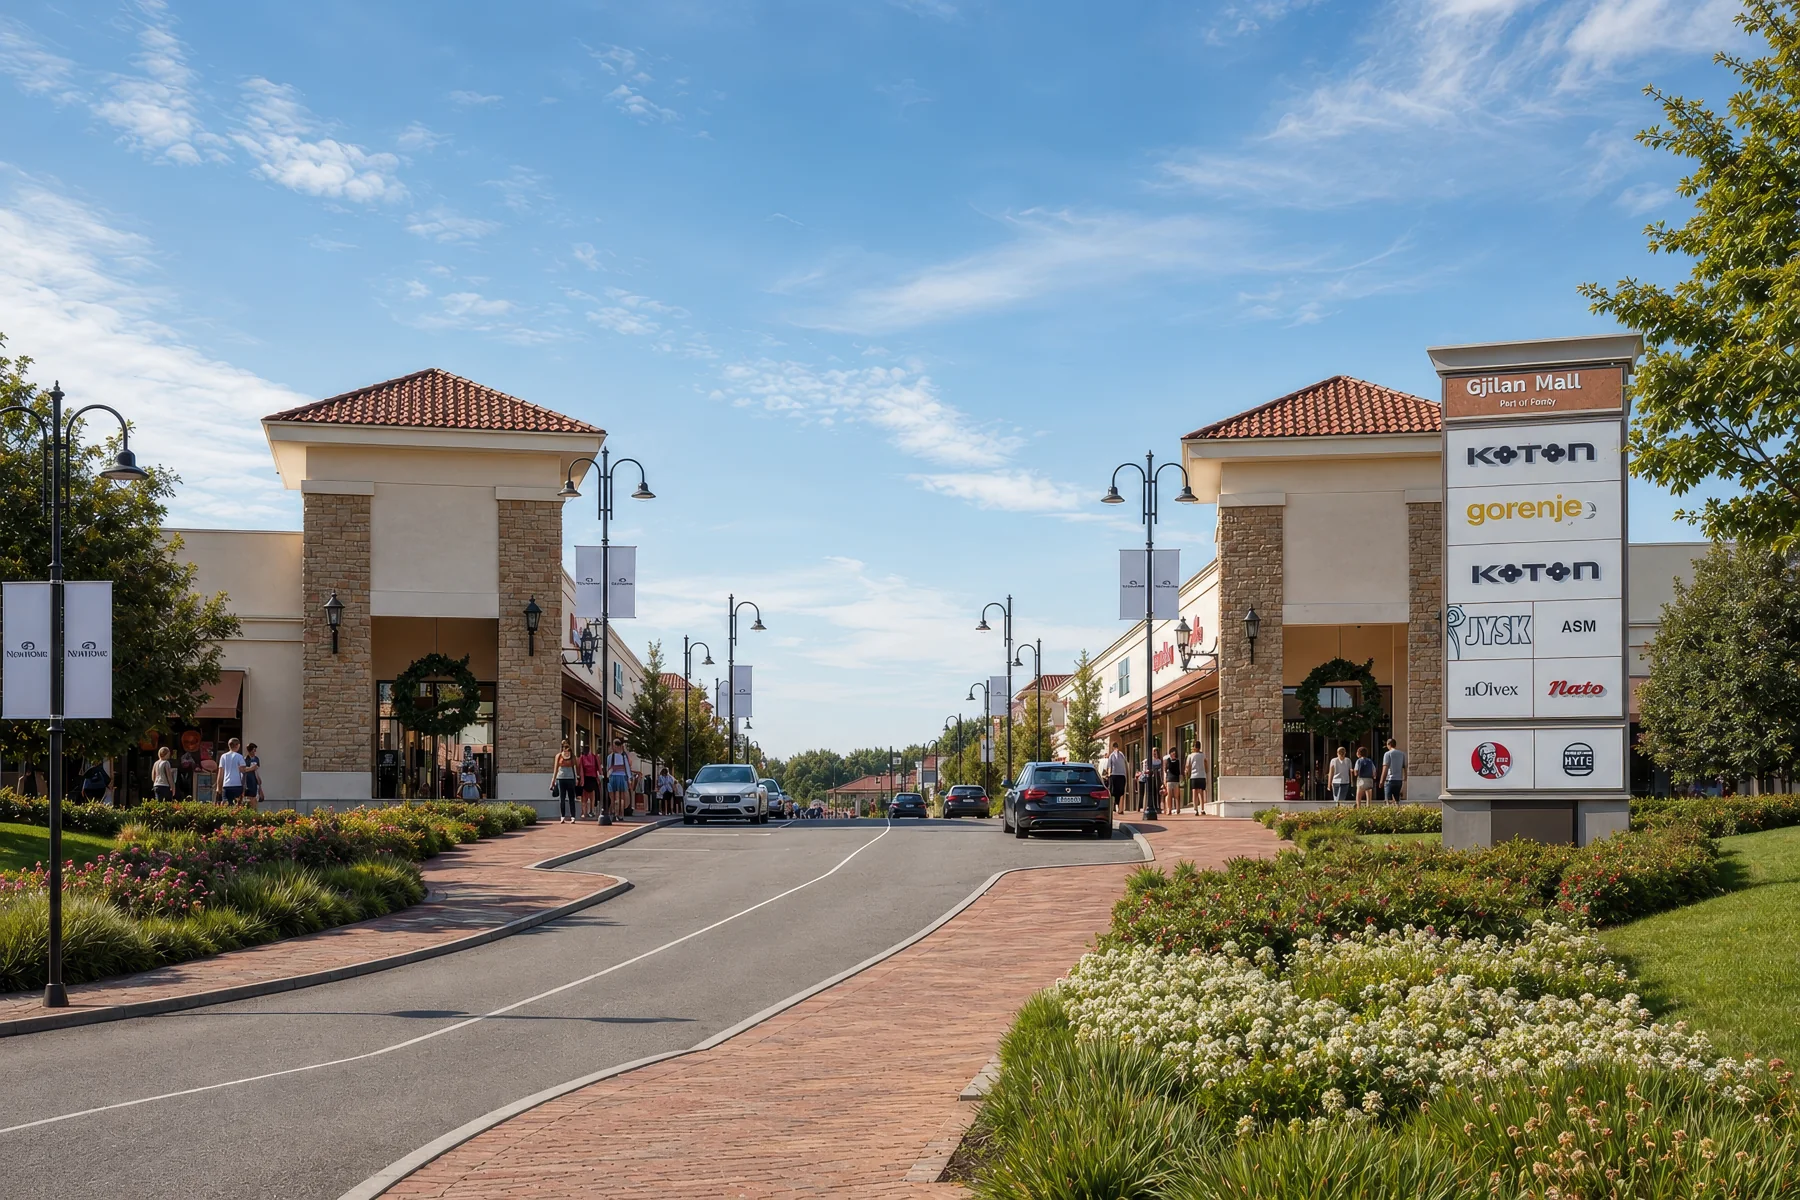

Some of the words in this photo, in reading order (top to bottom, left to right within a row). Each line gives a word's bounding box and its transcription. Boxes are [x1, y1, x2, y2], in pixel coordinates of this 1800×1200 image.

[1466, 376, 1527, 398] Gjilan
[1536, 373, 1582, 392] Mall
[1467, 442, 1596, 466] KOTON
[1466, 494, 1583, 527] gorenje
[1471, 561, 1600, 584] KOTON
[1465, 615, 1532, 646] JYSK
[1561, 620, 1597, 633] ASM
